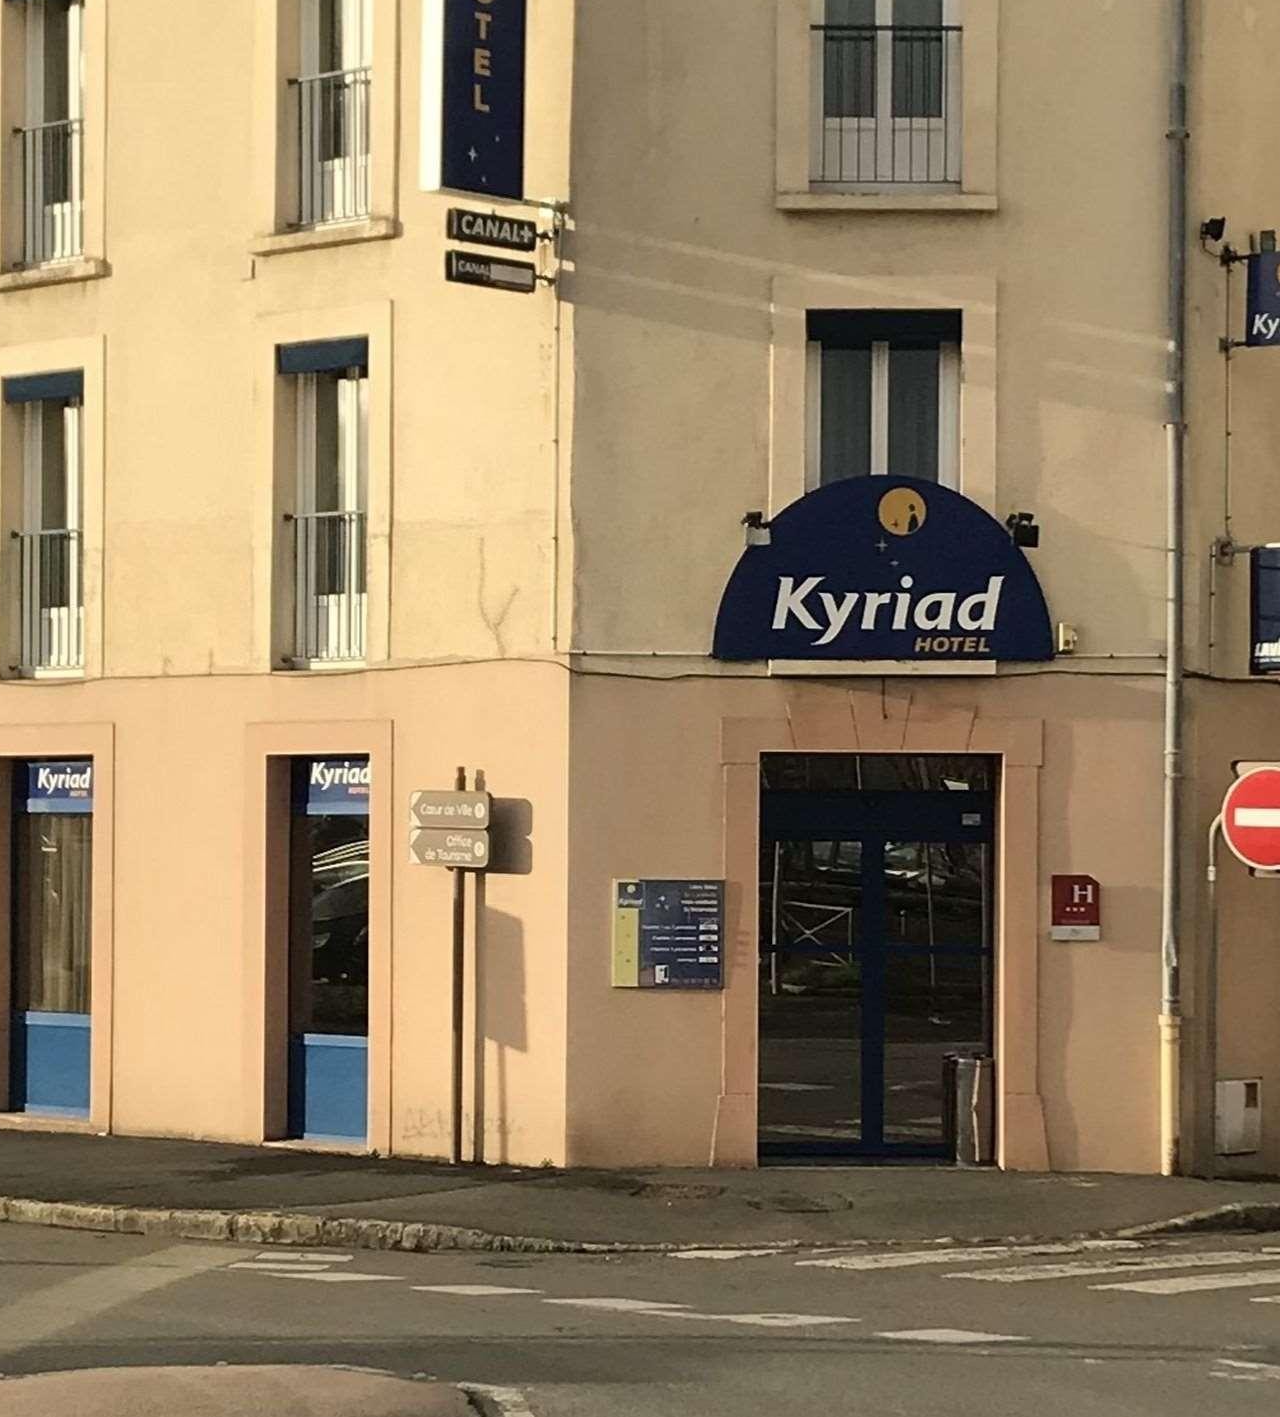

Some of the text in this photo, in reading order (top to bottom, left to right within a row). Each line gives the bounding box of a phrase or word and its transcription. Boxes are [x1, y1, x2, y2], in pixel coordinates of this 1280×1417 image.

[461, 215, 533, 243] CANAL+
[772, 575, 1006, 646] Kyriad
[915, 637, 991, 653] HOTEL
[37, 767, 91, 794] Kyriad
[310, 761, 370, 791] Kyriad
[446, 834, 472, 847] Office
[1073, 885, 1093, 903] H
